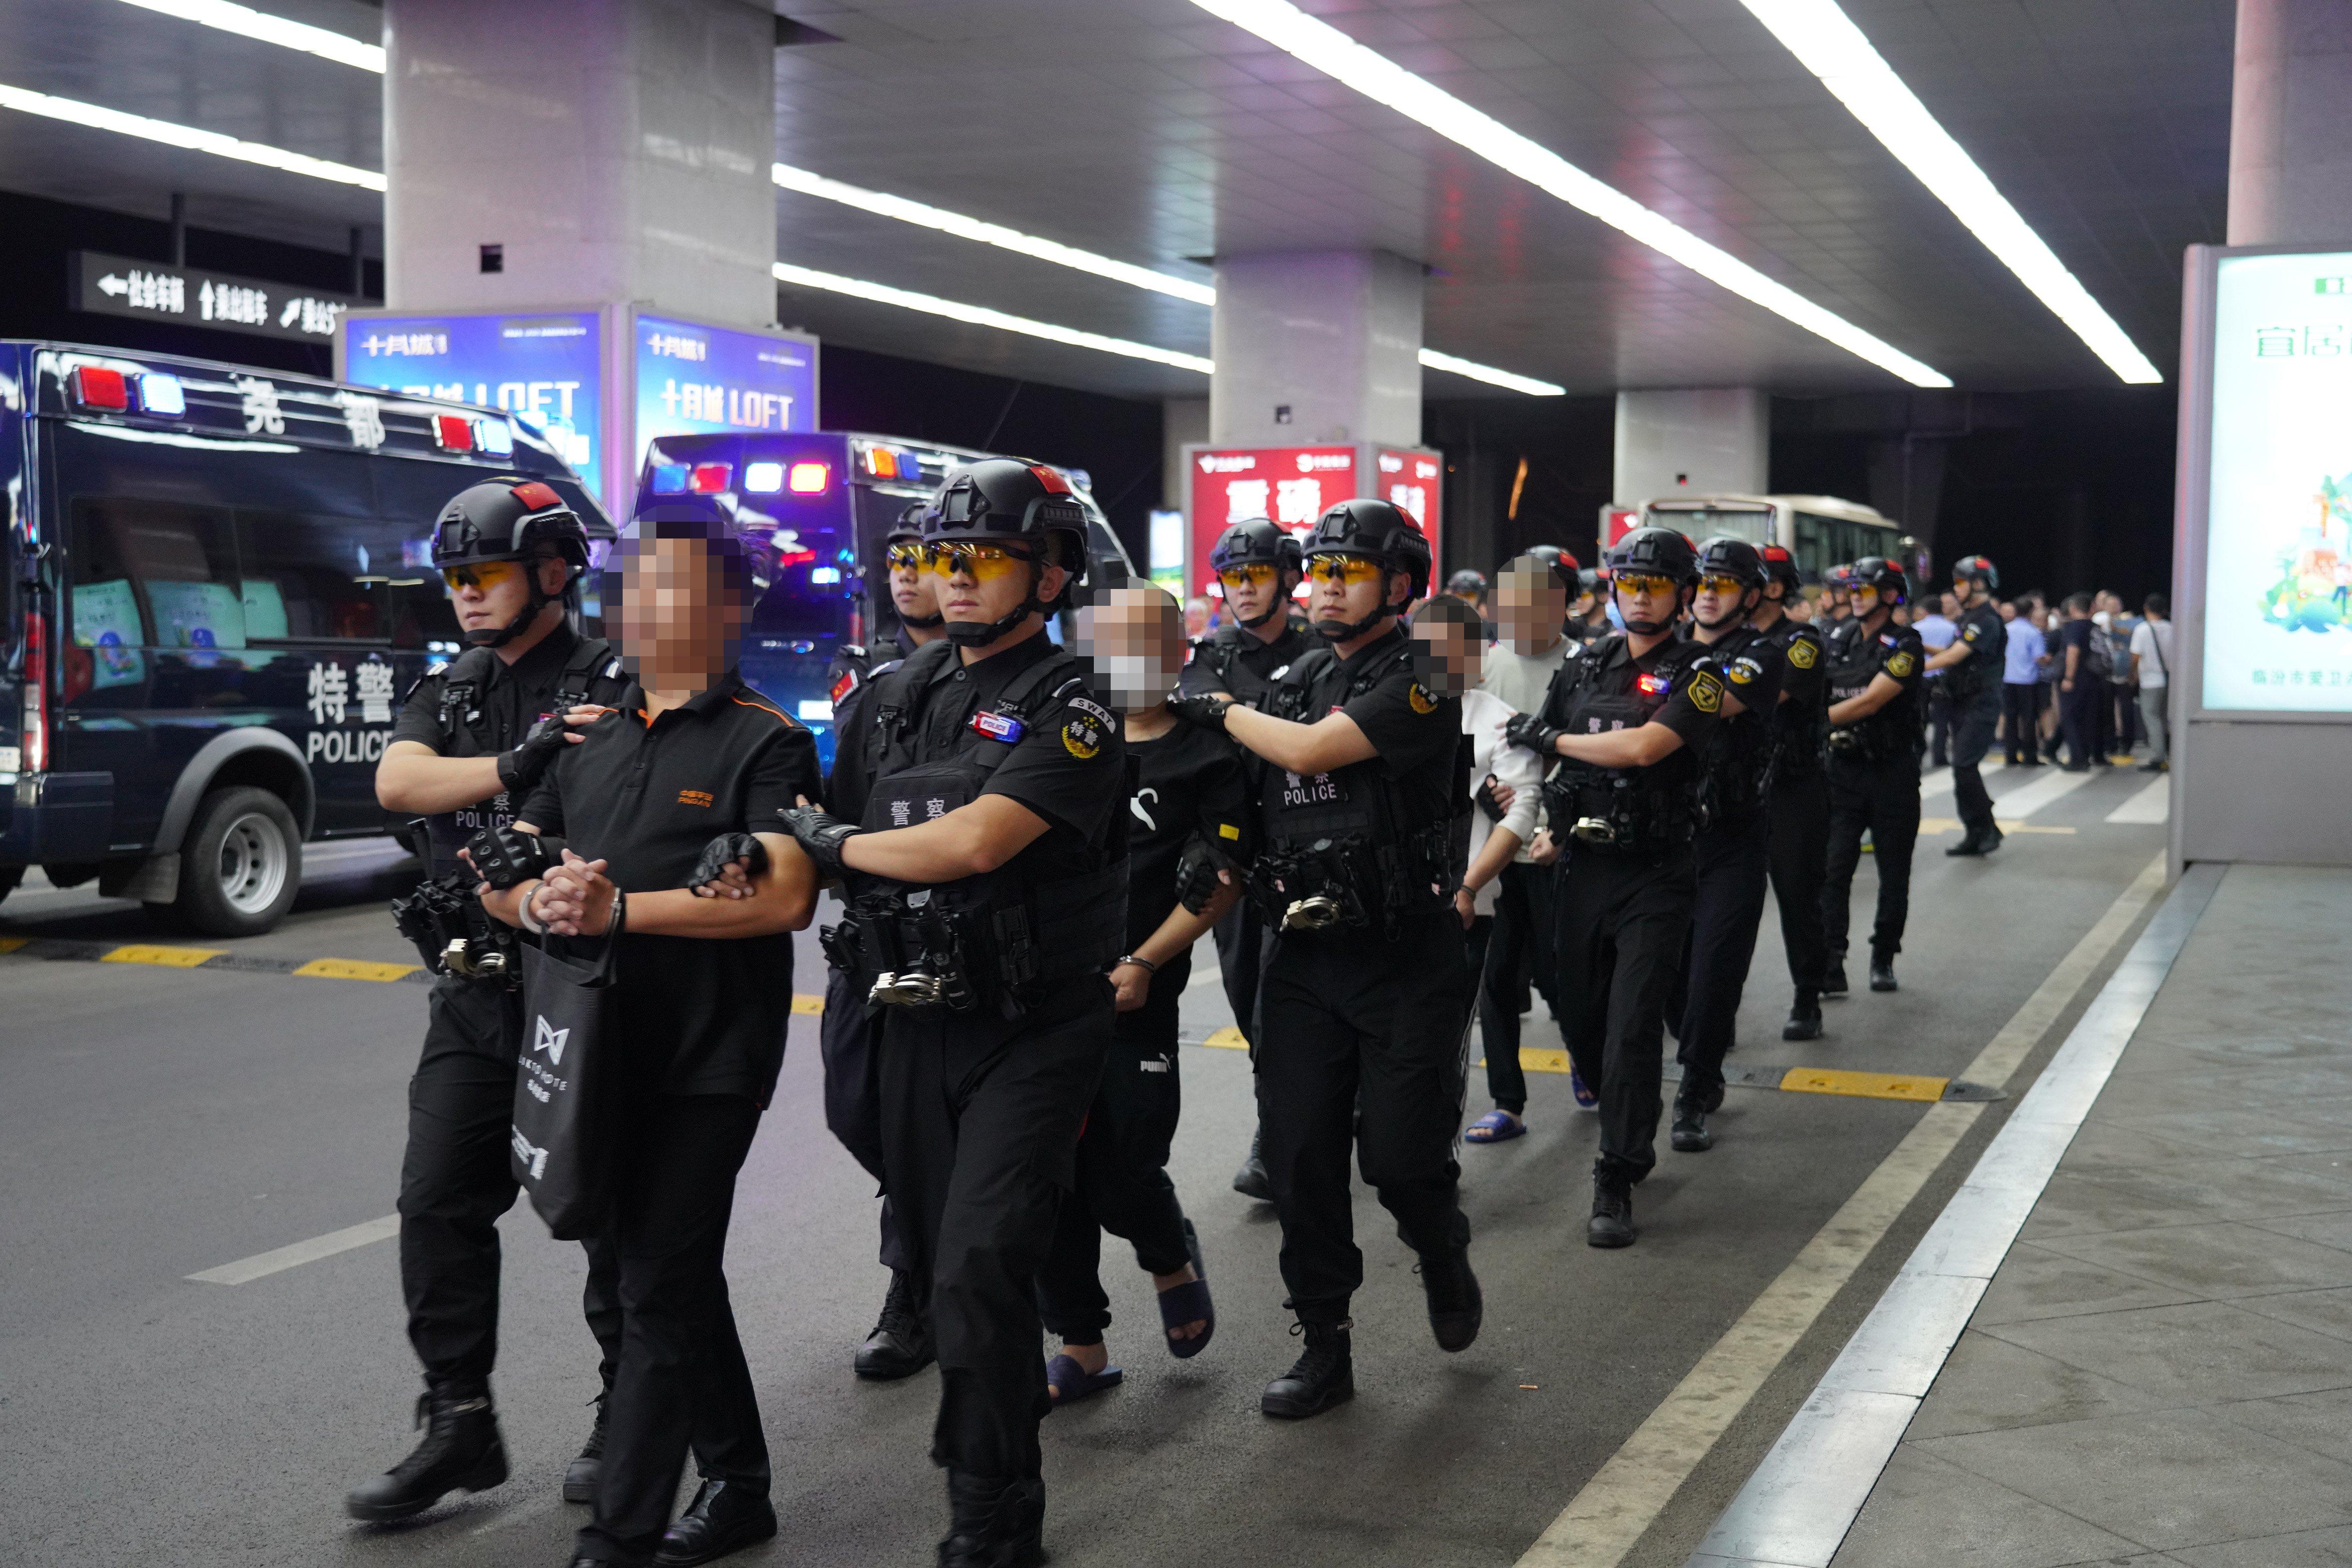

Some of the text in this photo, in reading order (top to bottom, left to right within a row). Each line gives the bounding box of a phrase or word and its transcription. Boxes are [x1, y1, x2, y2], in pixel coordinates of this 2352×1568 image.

[128, 269, 185, 313] 社会车辆
[215, 283, 268, 326] 乘出租车
[2256, 326, 2352, 356] 宜居
[729, 389, 793, 431] LOFT
[307, 662, 394, 725] 特警
[982, 720, 1007, 733] POLICE
[1078, 699, 1114, 725] SWAT
[1070, 721, 1098, 746] 特警
[1283, 783, 1337, 806] POLICE
[890, 798, 946, 826] 警察
